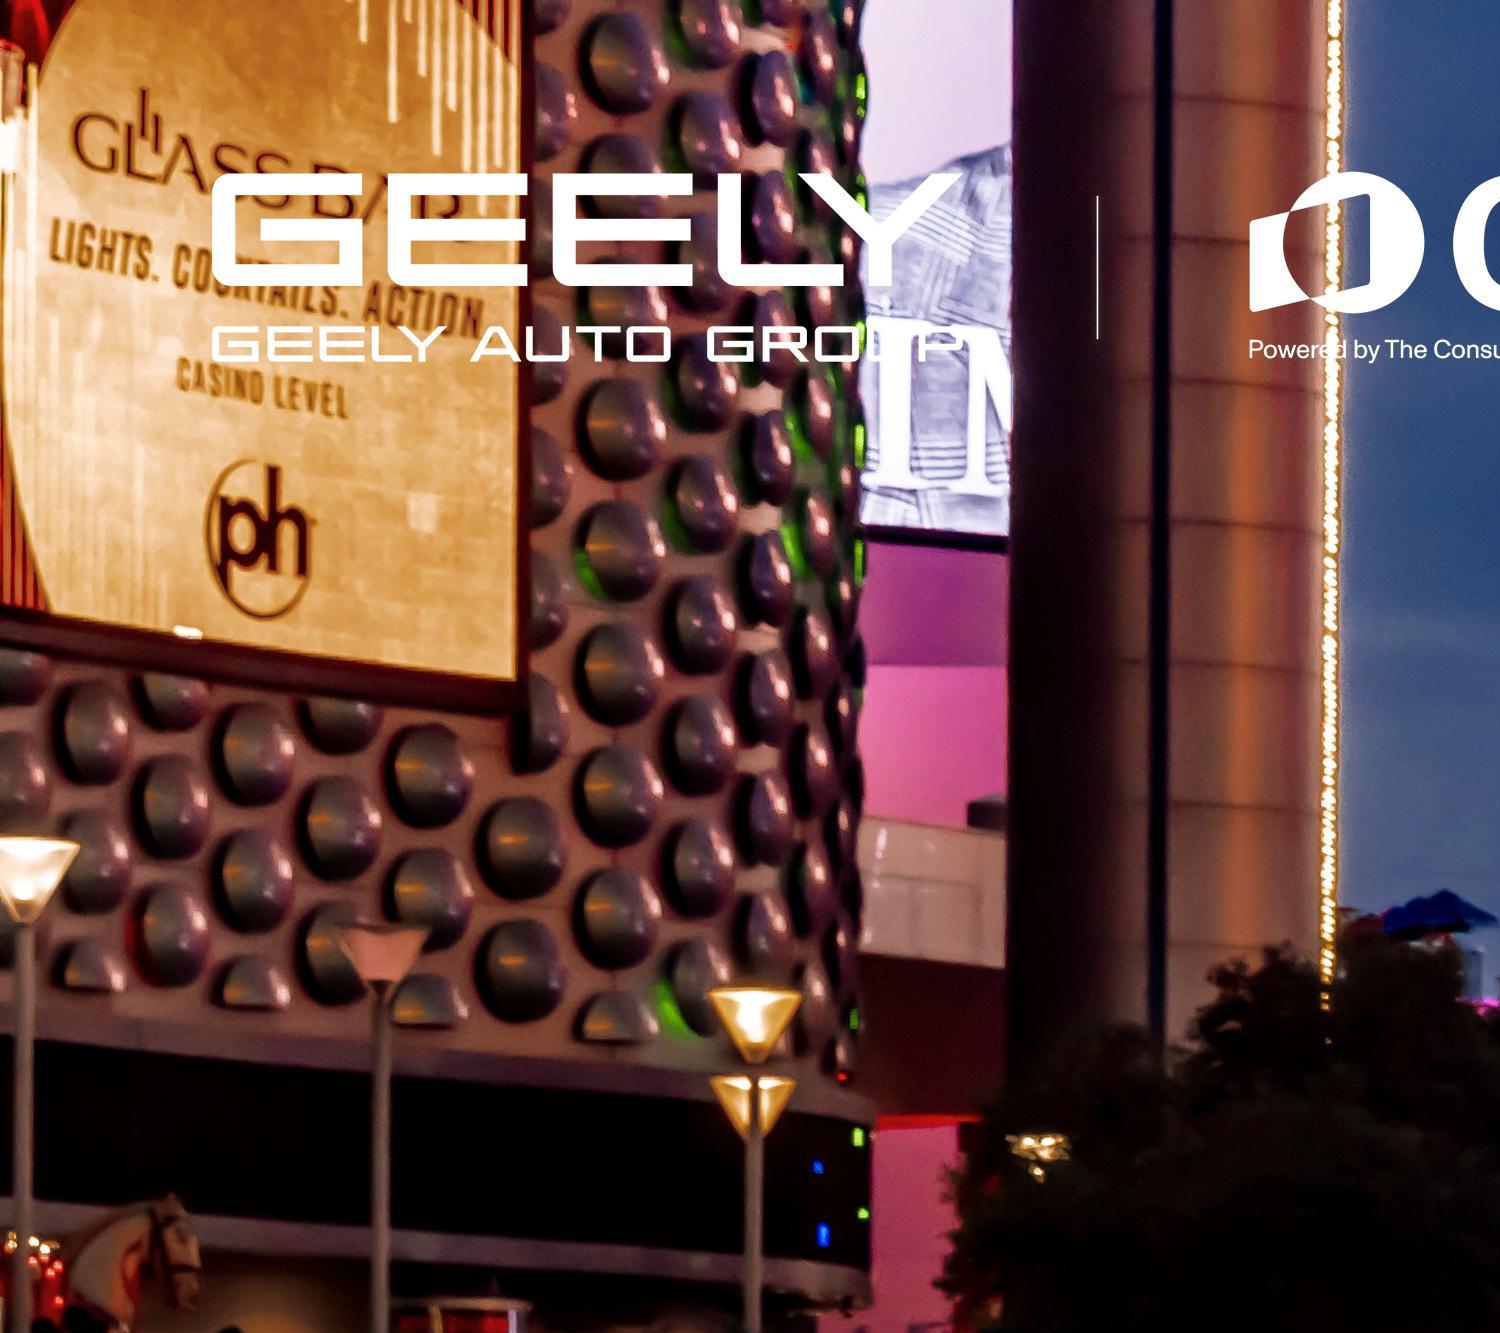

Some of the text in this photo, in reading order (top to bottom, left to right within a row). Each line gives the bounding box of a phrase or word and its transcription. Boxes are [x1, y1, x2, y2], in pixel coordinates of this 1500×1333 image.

[49, 216, 160, 283] LIGHTS.
[361, 278, 486, 341] ACTION
[175, 356, 350, 422] CASINO LEVEL
